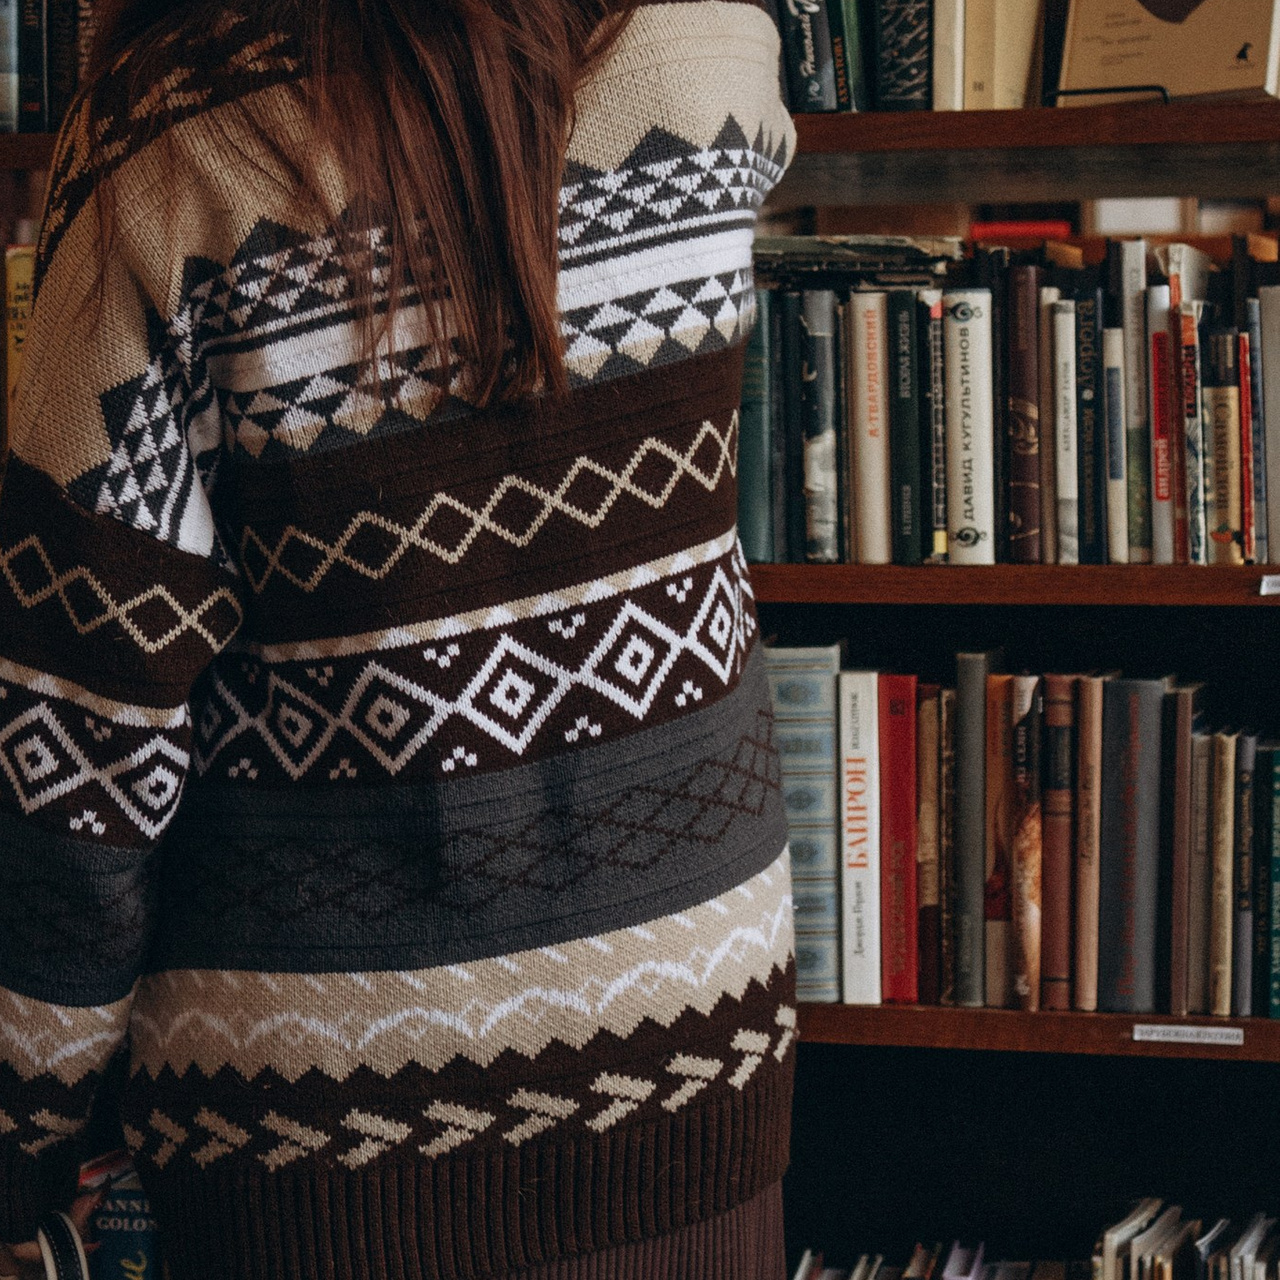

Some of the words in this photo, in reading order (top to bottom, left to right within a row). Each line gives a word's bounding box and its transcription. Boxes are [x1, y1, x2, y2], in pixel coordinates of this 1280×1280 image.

[833, 36, 850, 104] АХМАТОВА
[958, 327, 971, 451] КУГУЛЬТИНОВ
[1077, 299, 1096, 389] Дорога
[961, 458, 974, 521] ДАВИД
[1155, 437, 1169, 497] андрей
[1216, 402, 1233, 509] Самойлов
[843, 756, 868, 869] БАЙРОН
